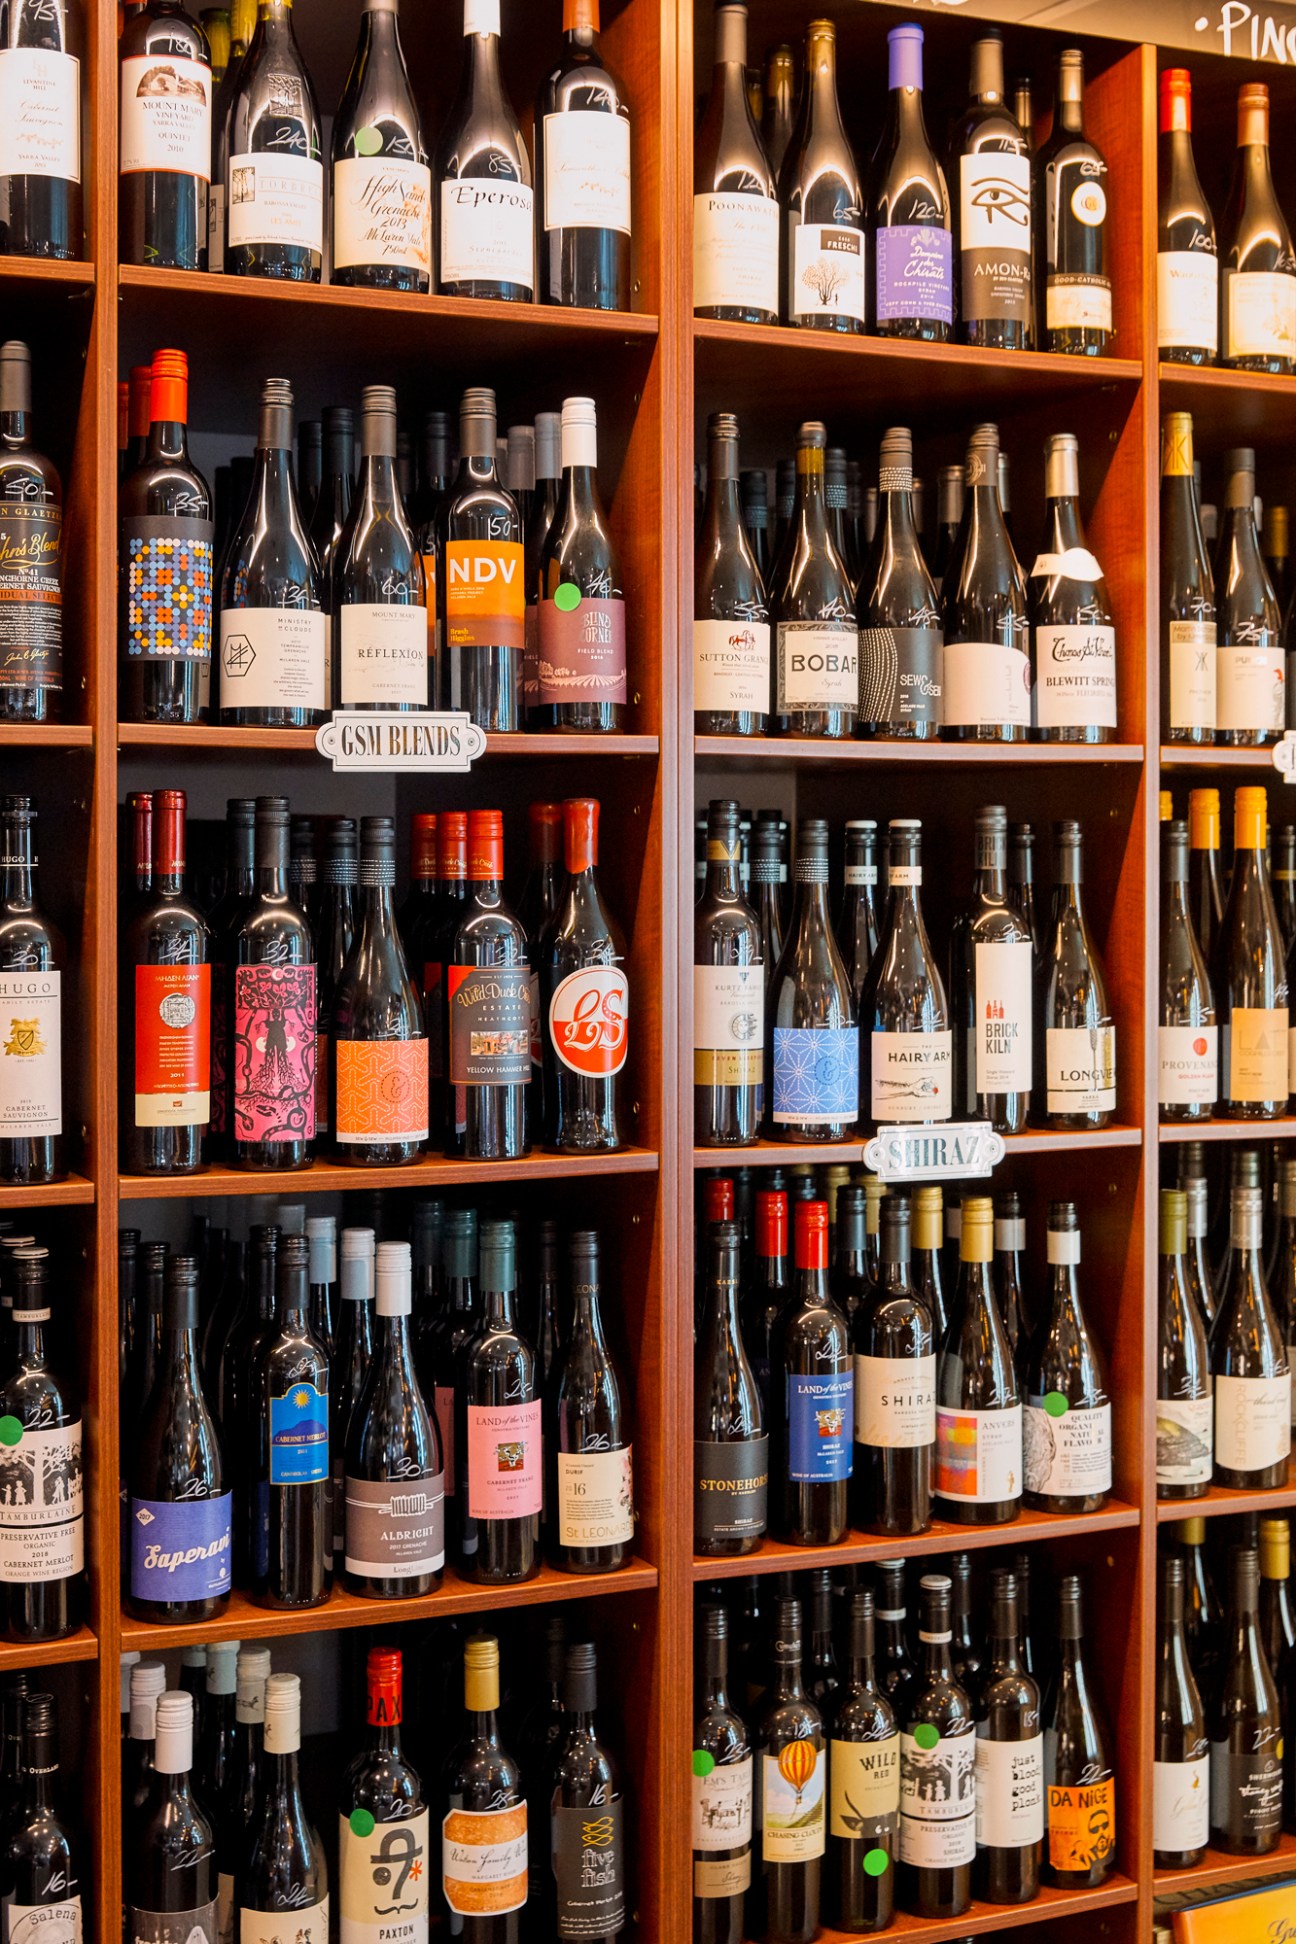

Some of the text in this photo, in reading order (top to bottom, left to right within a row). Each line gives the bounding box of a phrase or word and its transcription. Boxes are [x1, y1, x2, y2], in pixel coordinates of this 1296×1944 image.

[142, 101, 179, 111] MOUNT
[449, 557, 517, 585] NDV
[0, 576, 39, 586] NGHORNE
[372, 611, 398, 619] MOUNT
[277, 618, 312, 626] MINISTRY
[450, 627, 469, 636] Brush
[450, 635, 476, 643] Higgins
[699, 653, 741, 663] SUTTON
[1046, 676, 1089, 688] BLEWITT
[342, 725, 461, 756] GSM BLENDS
[0, 982, 51, 995] HUGO
[482, 1004, 522, 1012] ESTATE
[985, 1022, 1019, 1039] BRICK
[985, 1039, 1012, 1055] KILN
[888, 1052, 932, 1063] HAIRY
[465, 1065, 522, 1075] YELLOW HAMMER
[5, 1104, 46, 1112] CABERNET
[3, 1111, 49, 1120] SAUVIGNON
[888, 1137, 980, 1169] SHIRAZ
[798, 1384, 823, 1395] LAND
[475, 1416, 502, 1427] LAND
[275, 1434, 306, 1443] CABERNET
[565, 1468, 584, 1476] DURIF
[0, 1505, 77, 1521] TAMBURLAINE
[138, 1512, 152, 1521] 2017
[0, 1526, 76, 1543] PRESERVATIVE FREE
[144, 1526, 231, 1573] Saperavi
[4, 1553, 75, 1570] CABERNET MERLOT
[5, 1570, 31, 1578] ORANGE
[33, 1568, 51, 1577] WINE
[859, 1752, 897, 1772] WILD
[873, 1769, 890, 1780] RED
[1050, 1789, 1074, 1808] DA
[767, 1831, 800, 1843] CHASING
[582, 1848, 616, 1869] five
[581, 1864, 616, 1888] fish
[29, 1908, 77, 1925] Salena
[379, 1924, 414, 1941] PAXTON
